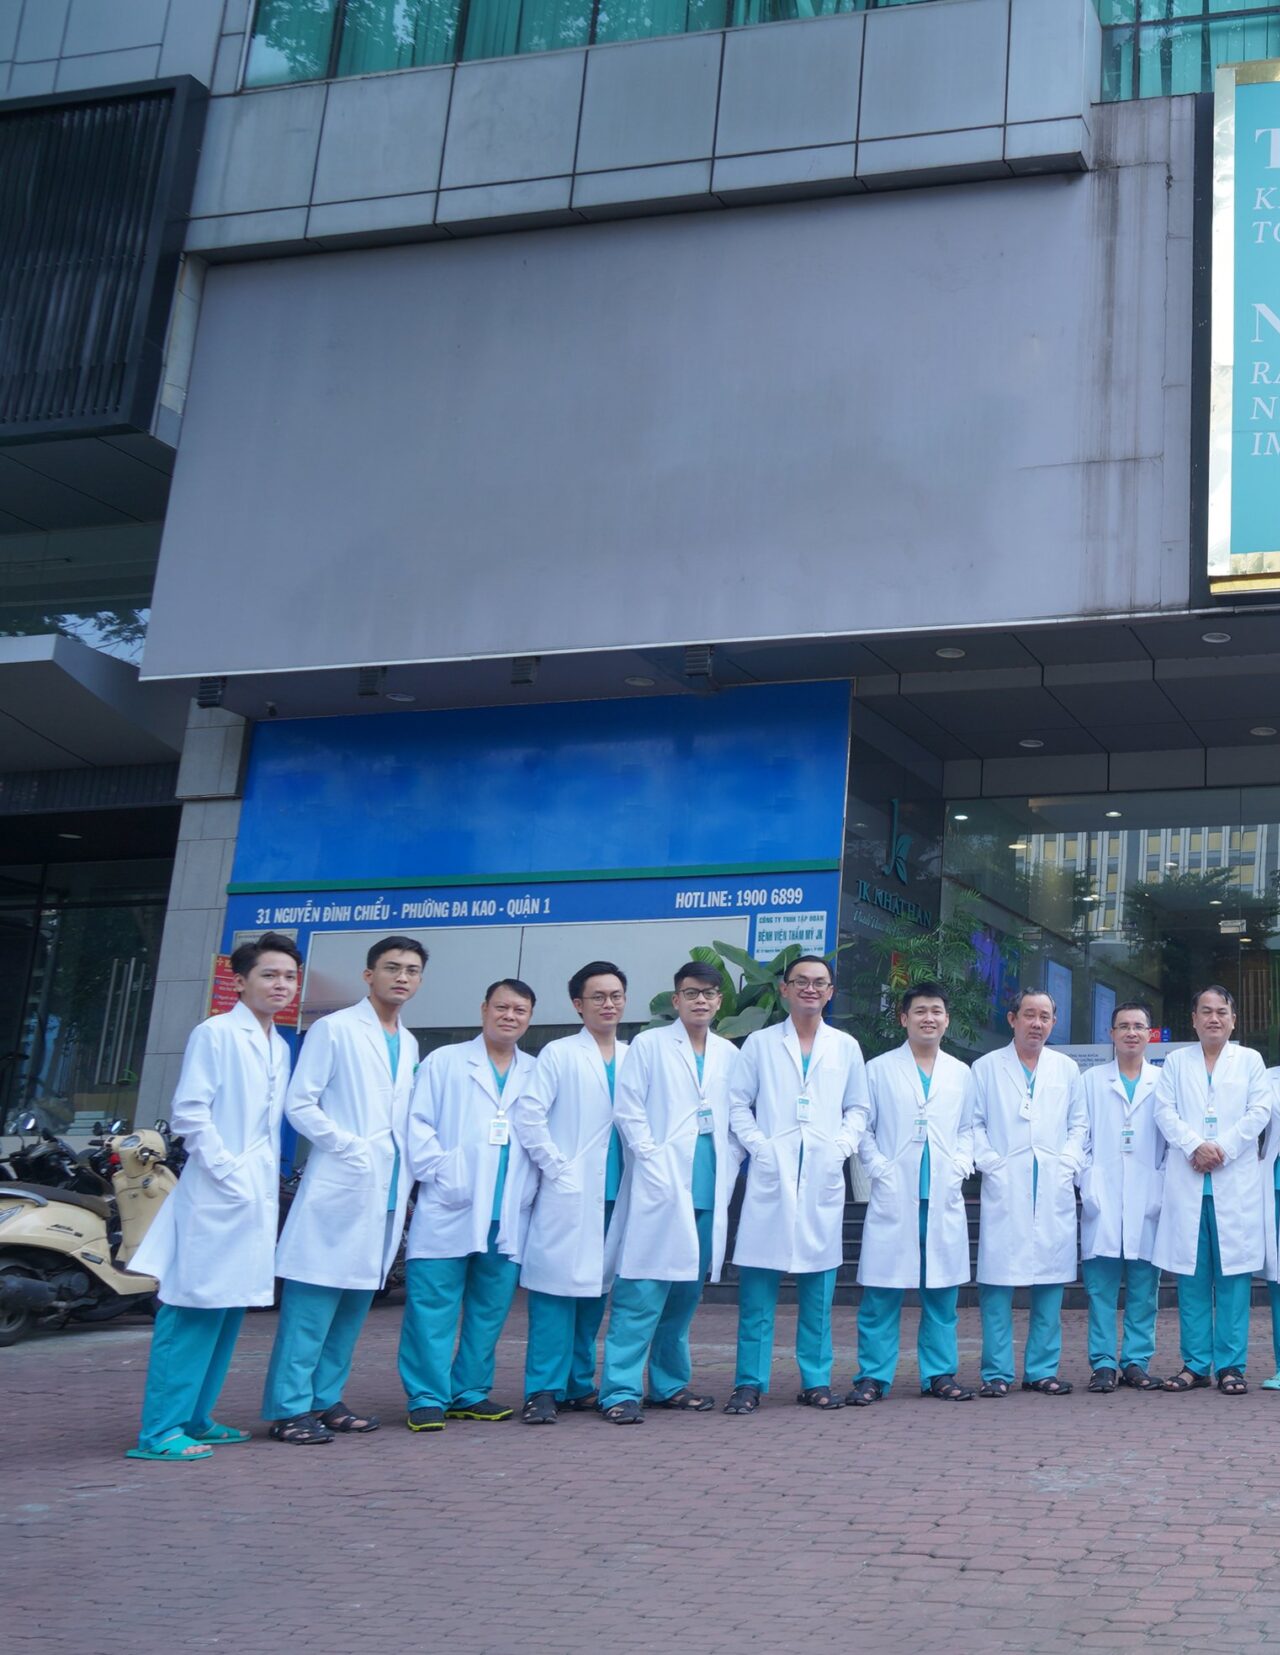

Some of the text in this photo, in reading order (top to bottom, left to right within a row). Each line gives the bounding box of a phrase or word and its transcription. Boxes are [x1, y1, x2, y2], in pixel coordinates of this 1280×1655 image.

[255, 908, 271, 924] 31
[273, 900, 321, 924] NGUYỄN
[322, 902, 351, 923] ĐÌNH
[353, 897, 391, 921] CHIỂU
[401, 899, 450, 920] PHƯỜNG
[451, 901, 469, 918] ĐA
[471, 899, 497, 917] KAO
[506, 894, 540, 919] QUẬN
[543, 897, 551, 914] 1
[675, 887, 804, 909] HOTLINE: 1900 6899
